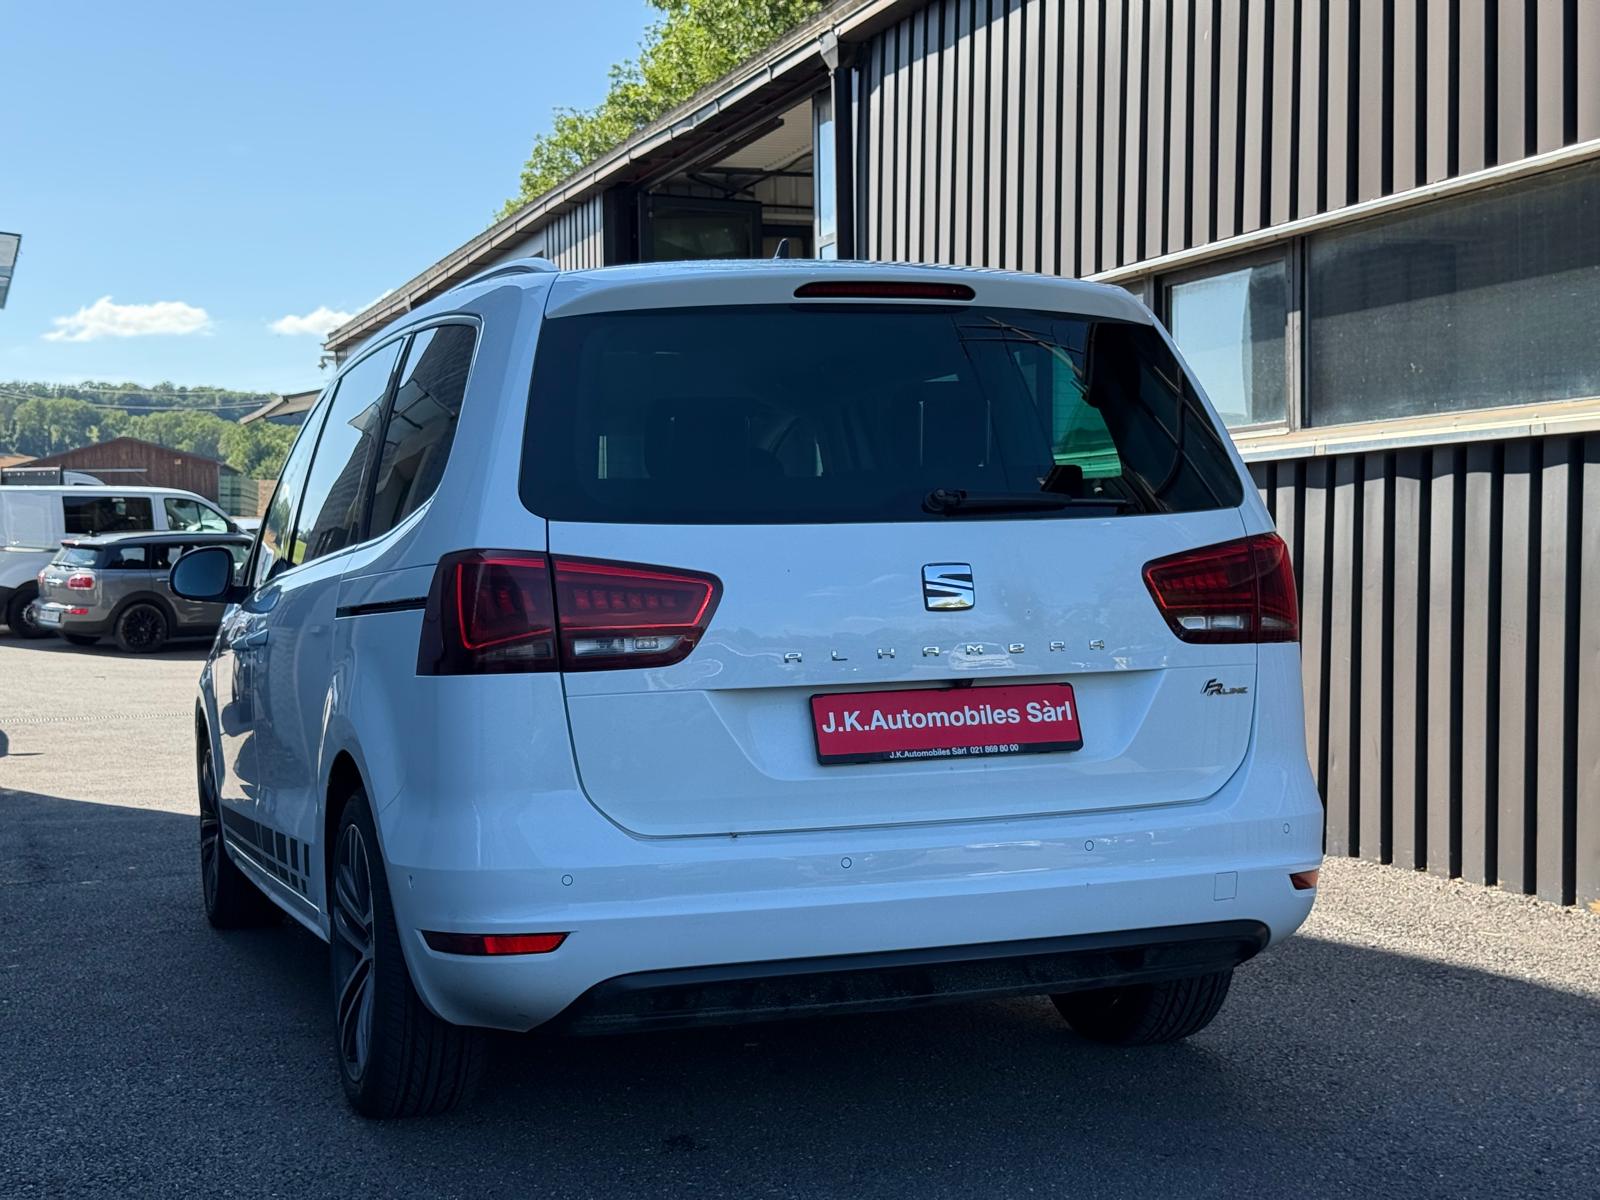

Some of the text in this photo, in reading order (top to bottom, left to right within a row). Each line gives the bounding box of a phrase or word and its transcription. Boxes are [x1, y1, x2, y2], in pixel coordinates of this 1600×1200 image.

[784, 639, 1105, 663] ALHAMBRA
[821, 699, 1073, 733] J.K.Automobiles Sàrl
[889, 748, 951, 759] J.K.Automobiles
[970, 746, 983, 754] 021
[1010, 743, 1019, 752] 00
